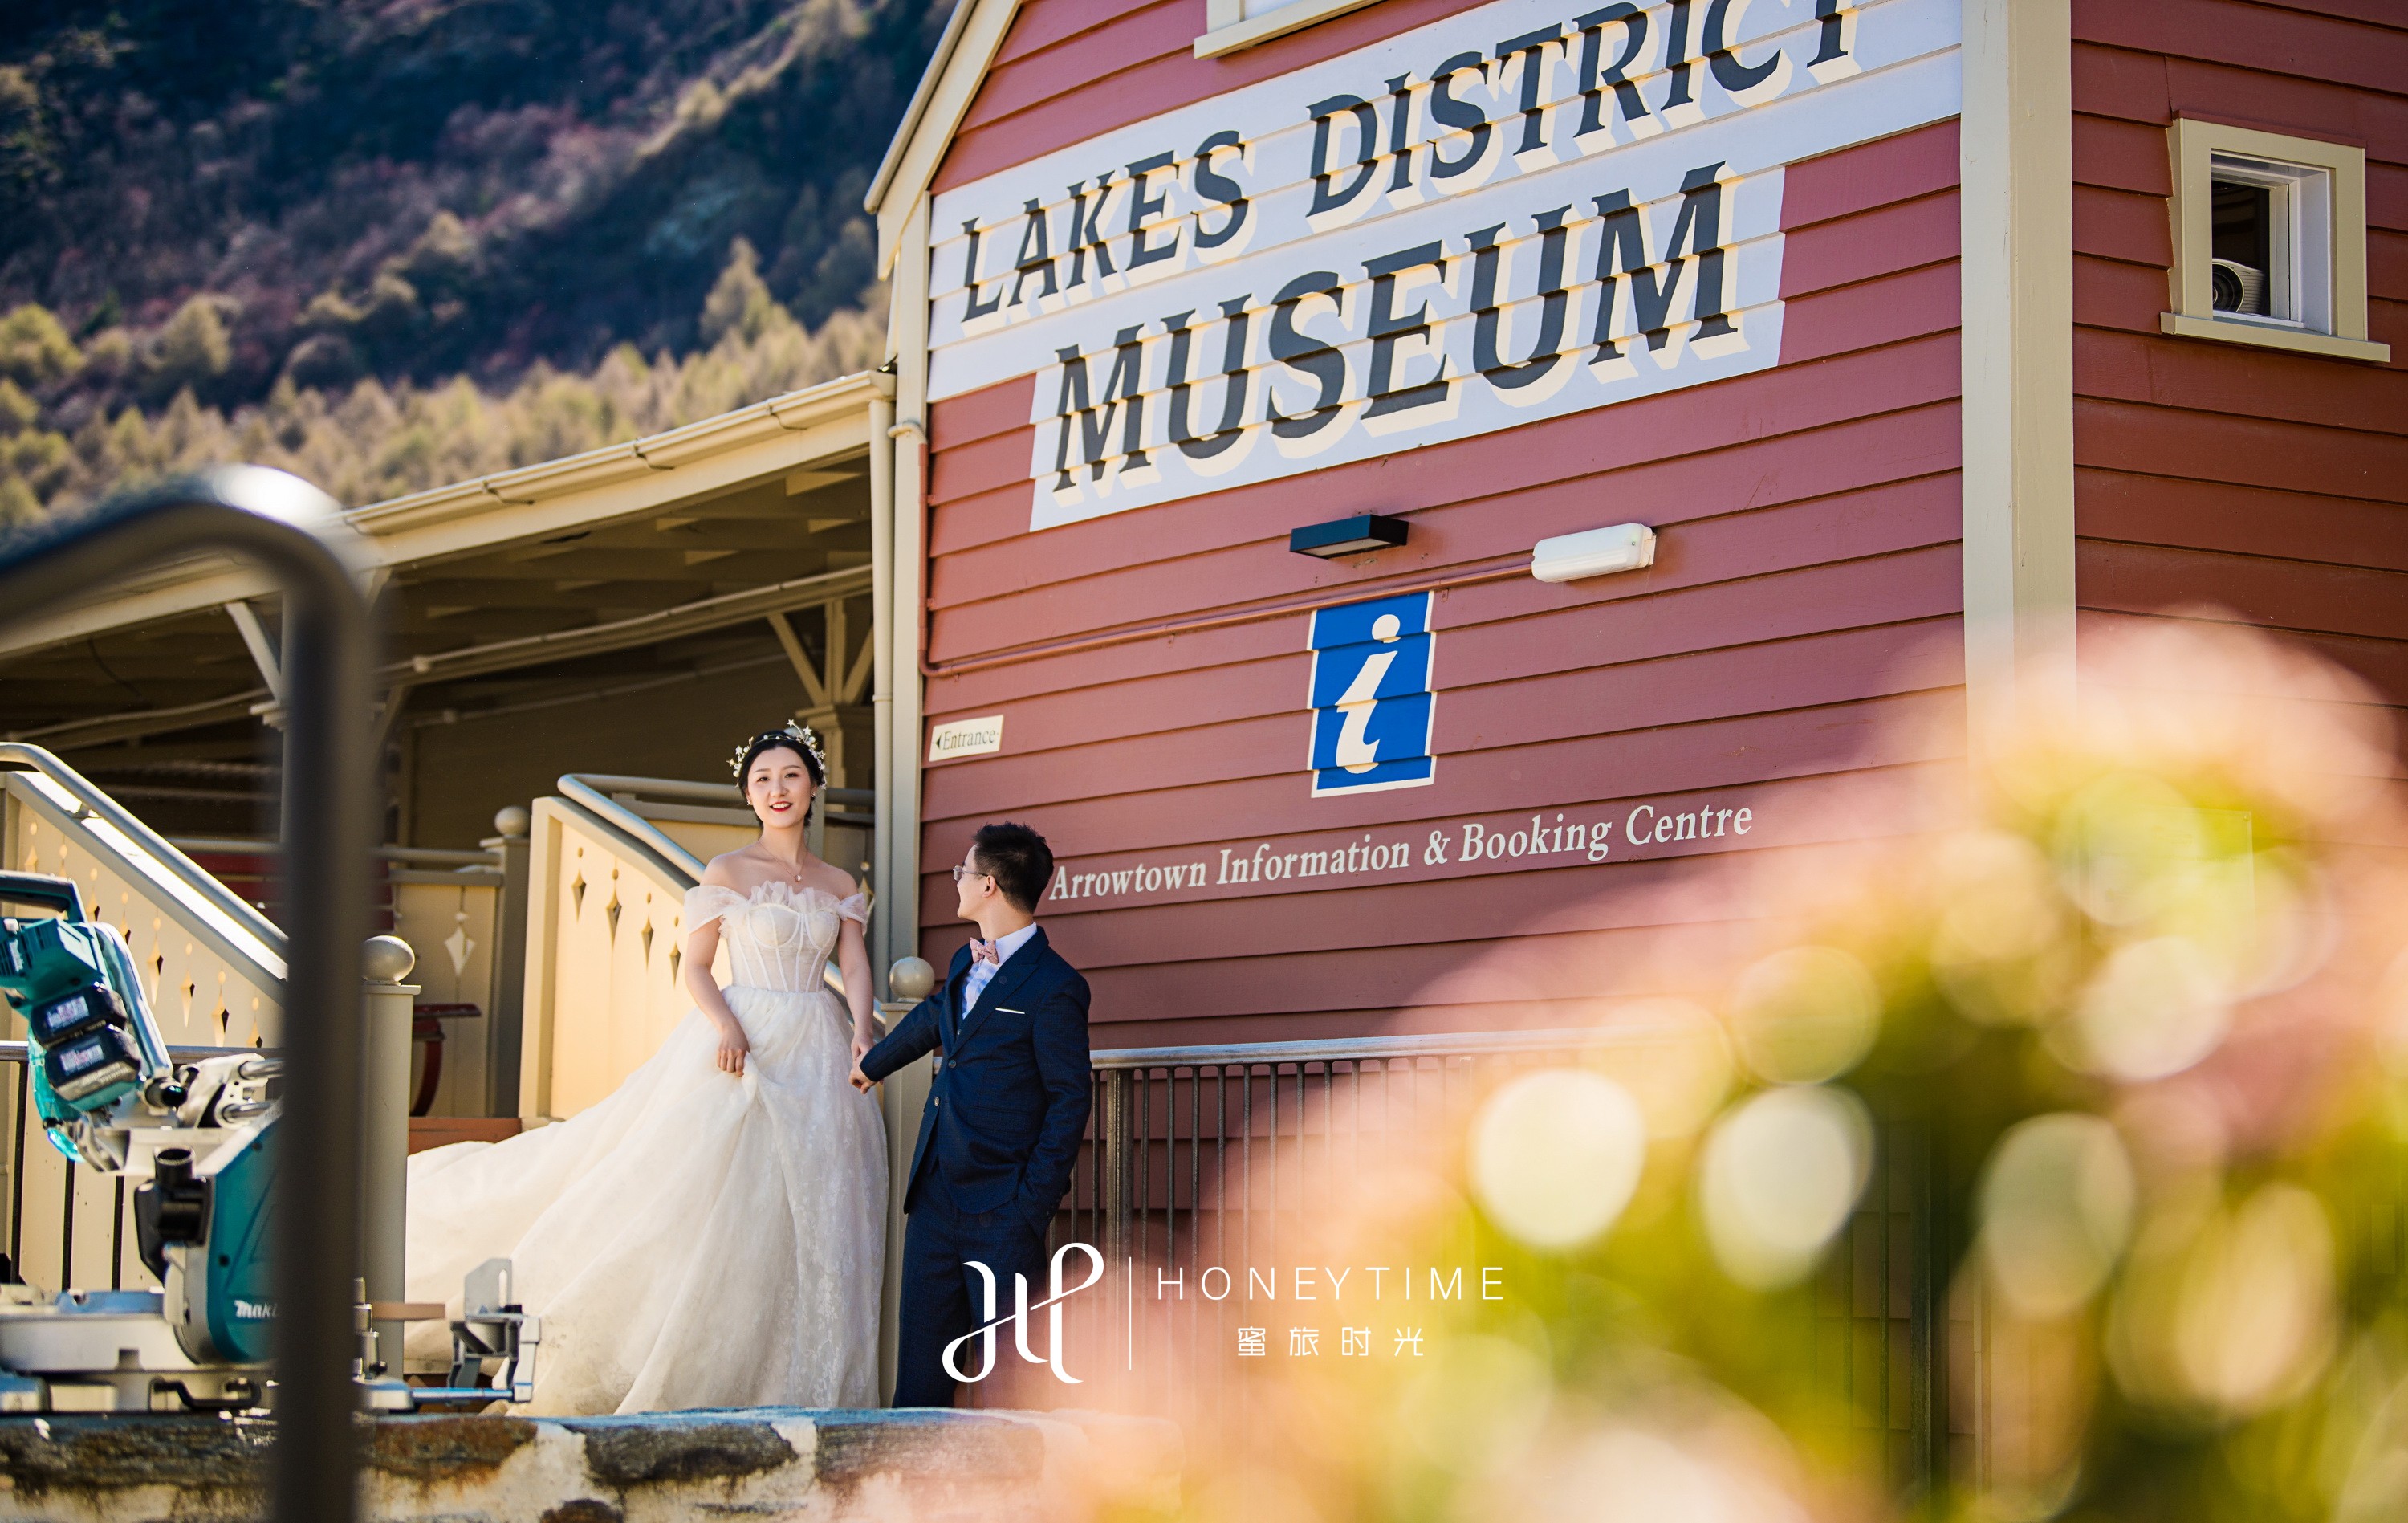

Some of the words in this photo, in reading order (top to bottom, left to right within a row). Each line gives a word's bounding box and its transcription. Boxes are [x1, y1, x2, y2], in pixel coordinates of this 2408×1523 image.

[962, 129, 1250, 323] LAKES
[1052, 161, 1739, 494] MUSEUM
[943, 728, 995, 751] Entrance
[1048, 862, 1207, 901] Arrowtown
[1216, 833, 1410, 885] Information
[1423, 830, 1451, 865] &
[1459, 813, 1613, 862] Booking
[1625, 804, 1753, 845] Centre
